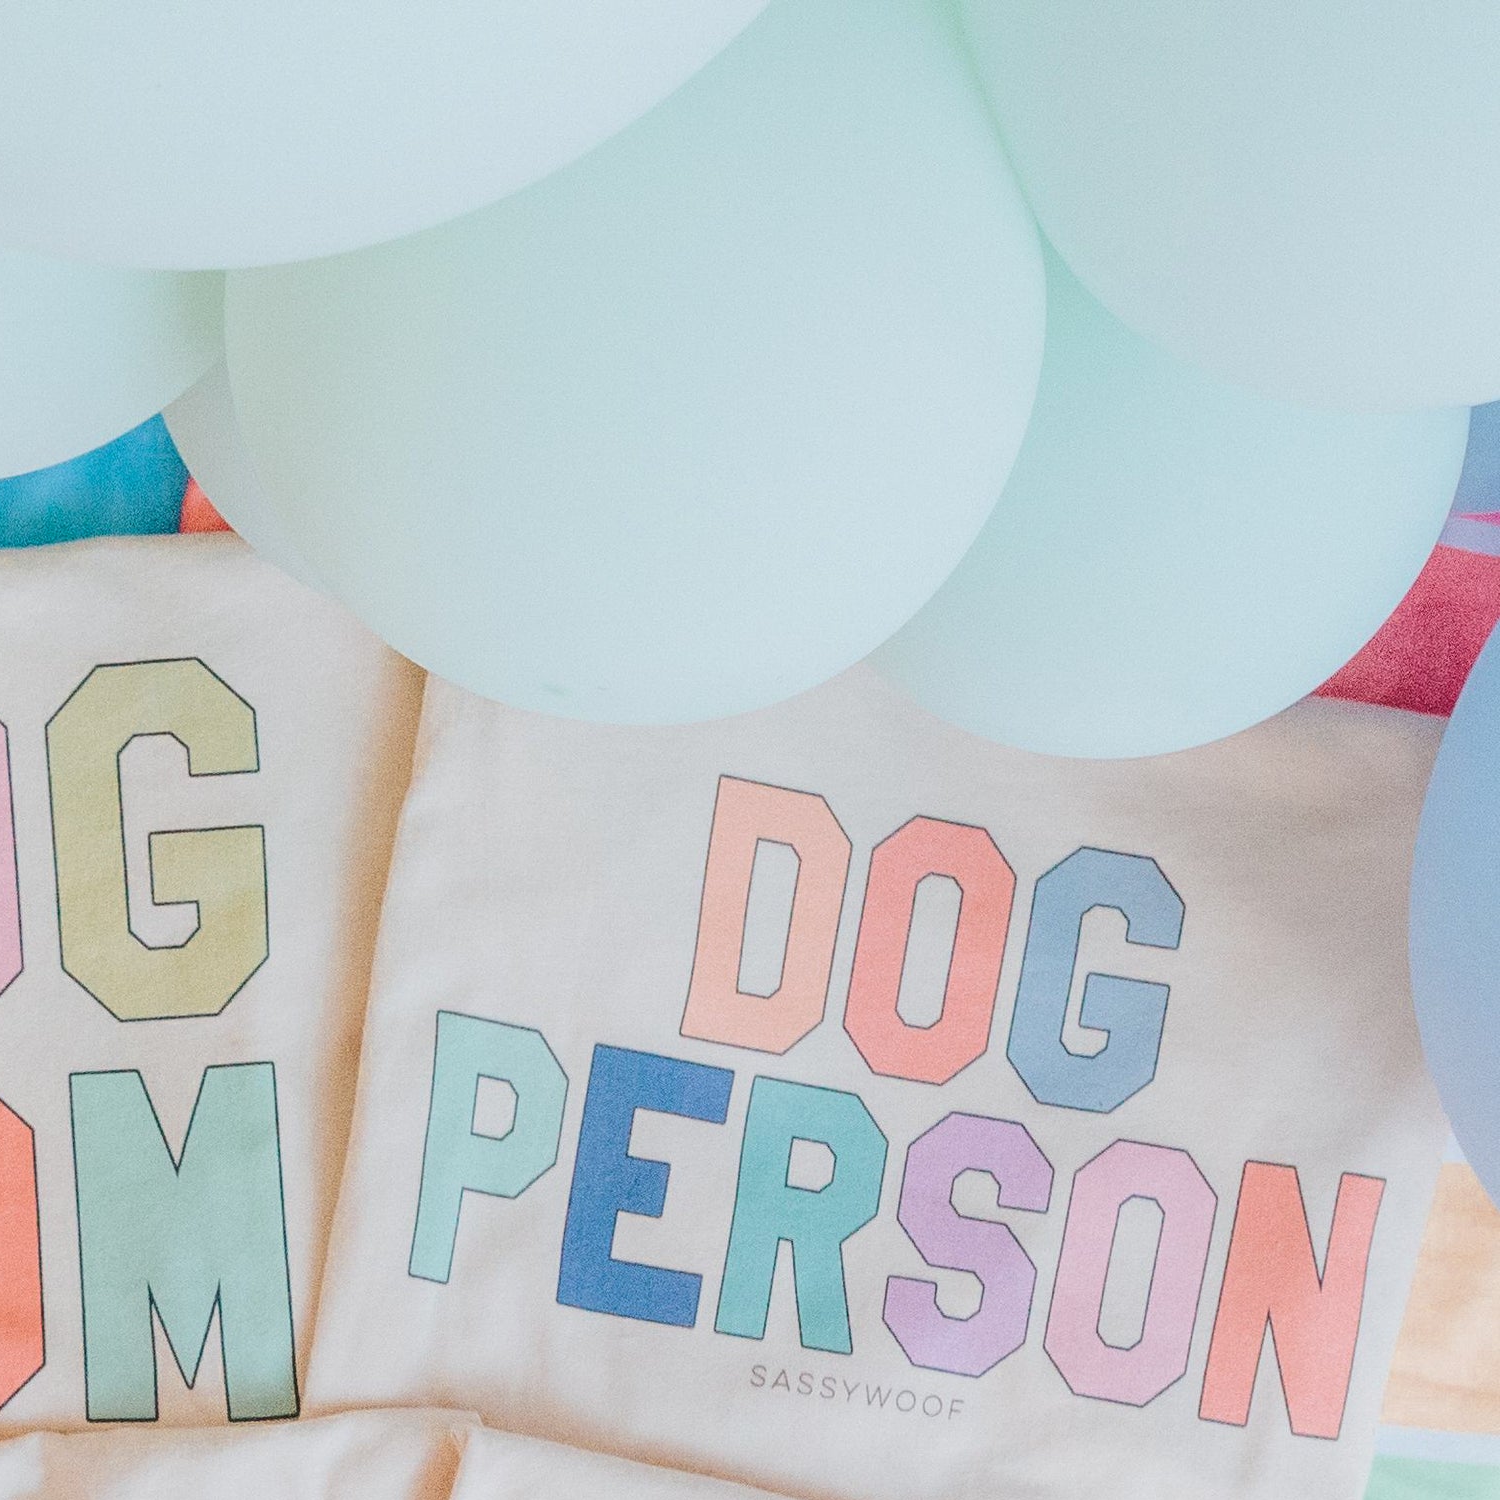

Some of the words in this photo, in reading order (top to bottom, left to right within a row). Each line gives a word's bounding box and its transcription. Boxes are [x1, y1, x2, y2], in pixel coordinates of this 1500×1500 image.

[680, 774, 1186, 1114] DOG
[408, 1010, 1387, 1441] PERSON
[750, 1364, 965, 1420] SASSYWOOF
